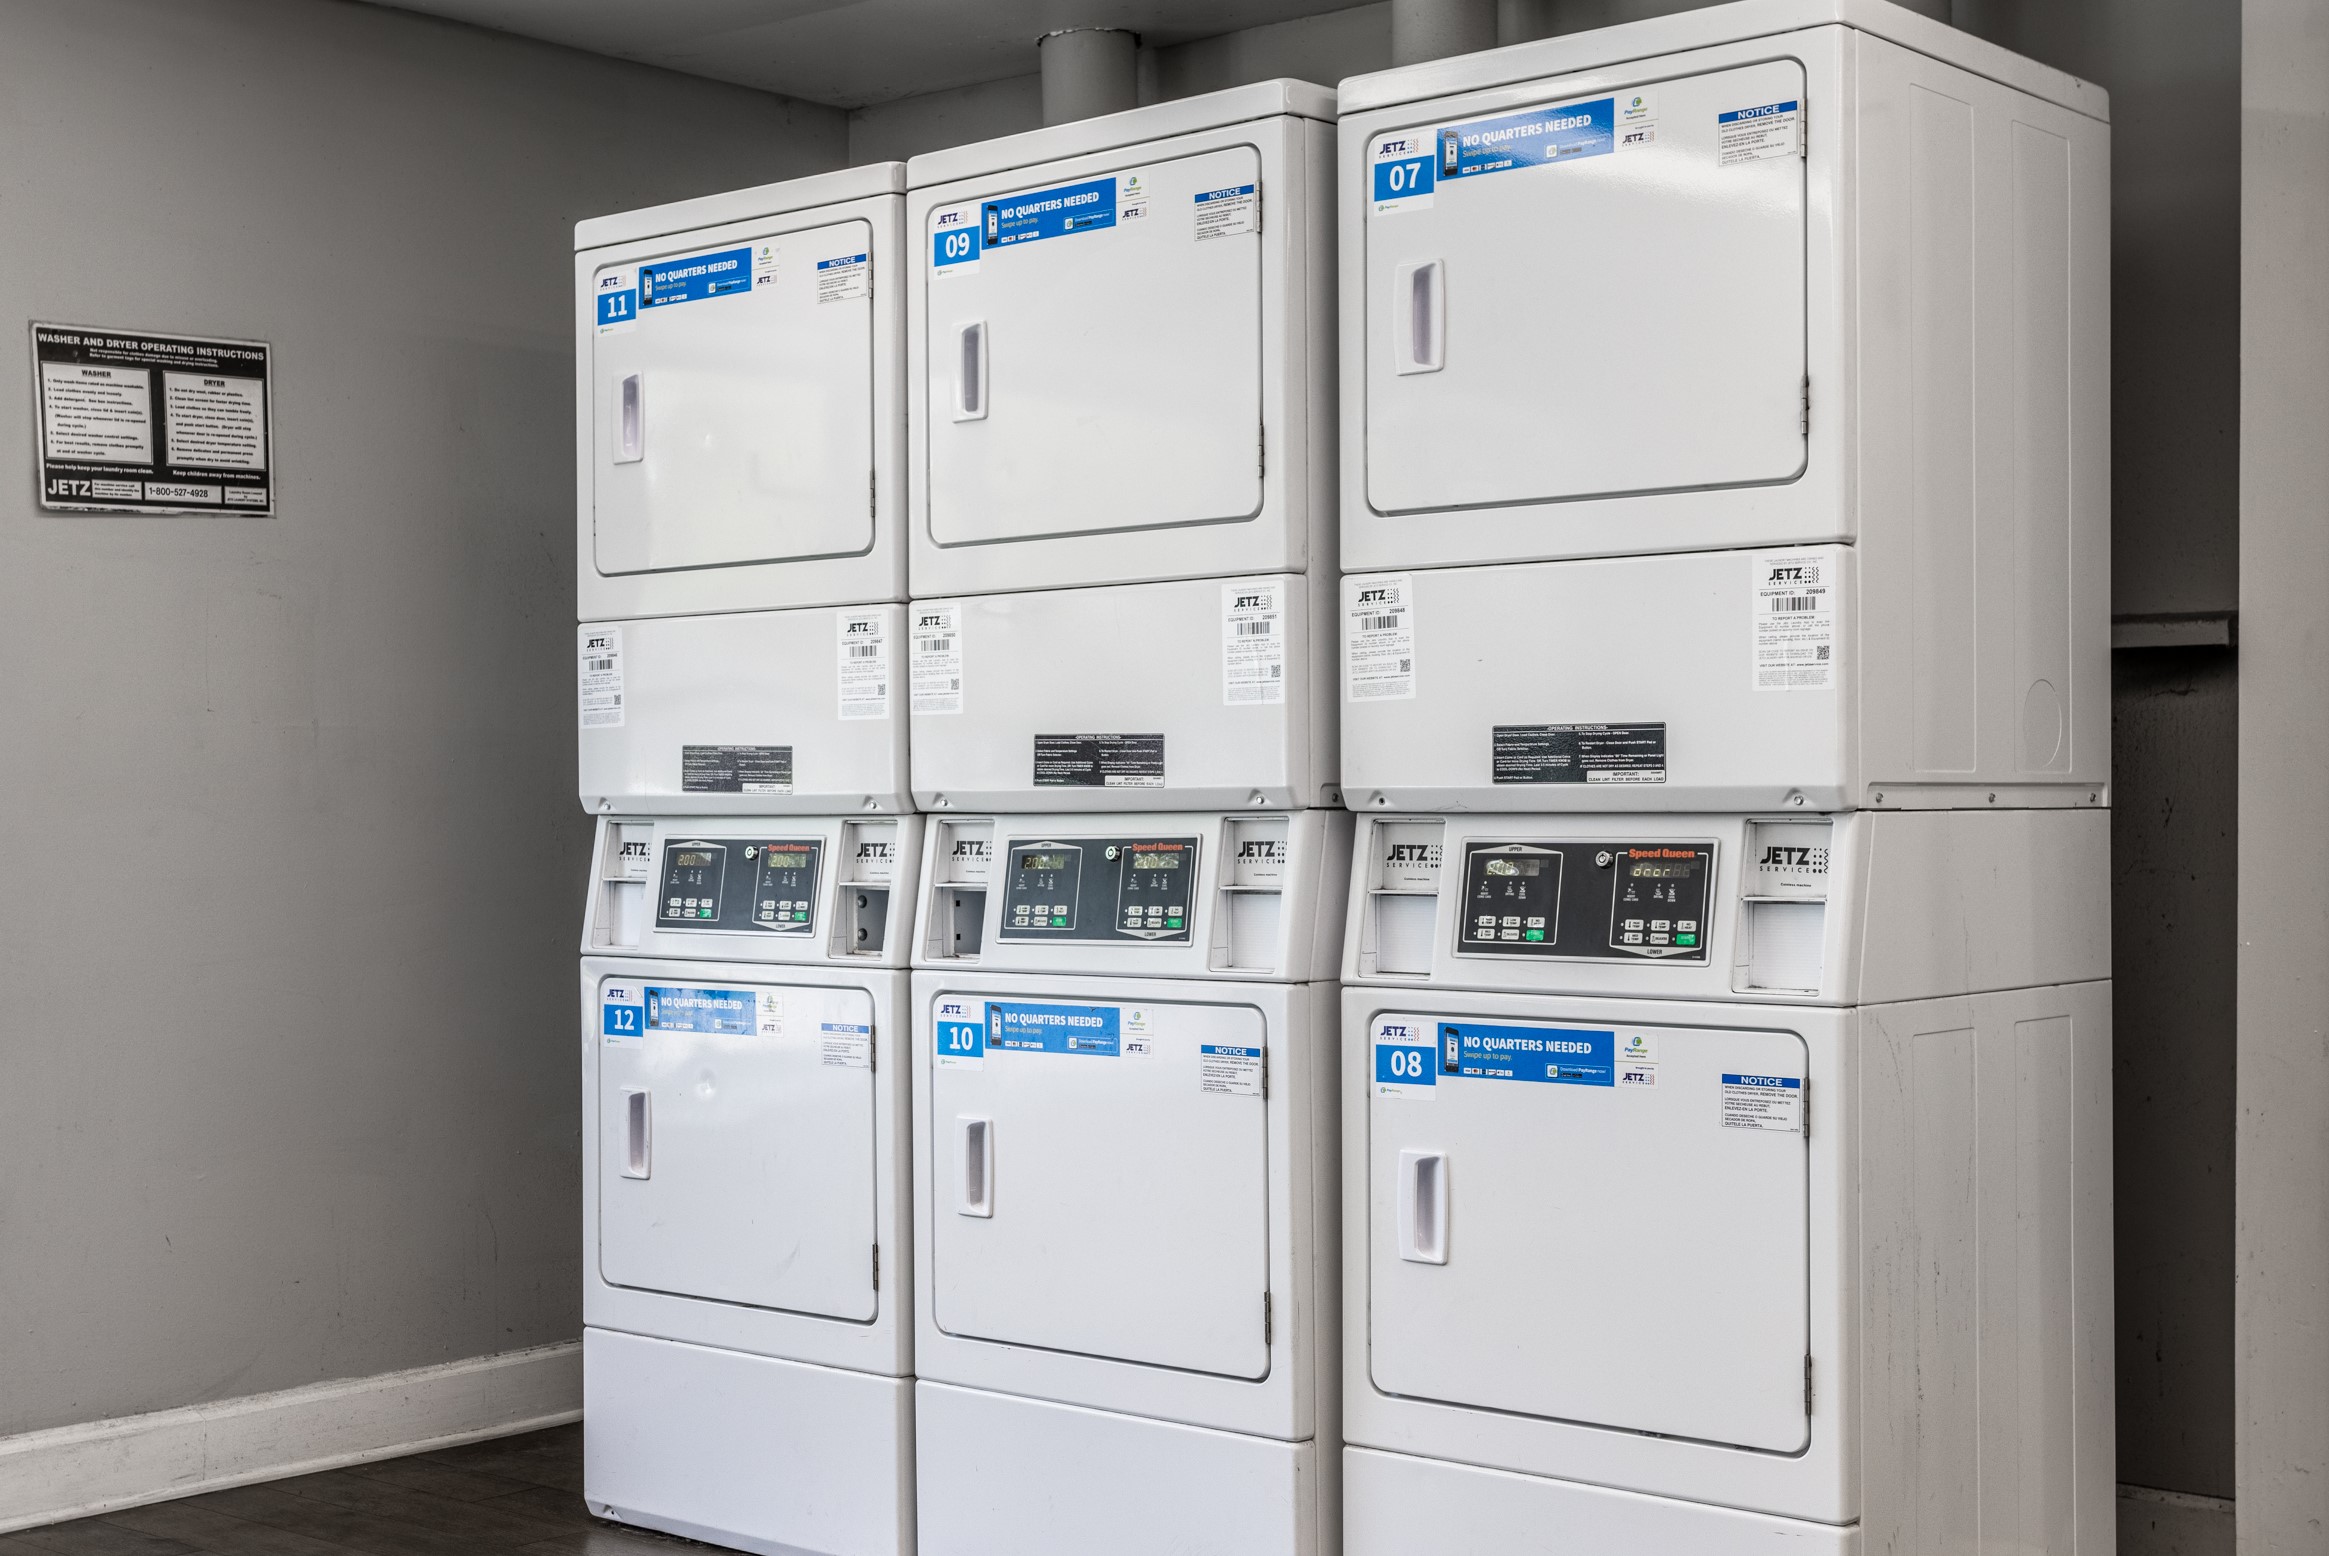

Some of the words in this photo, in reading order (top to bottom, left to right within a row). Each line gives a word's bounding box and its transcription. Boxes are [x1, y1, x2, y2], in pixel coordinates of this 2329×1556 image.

[1738, 104, 1780, 119] NOTICE
[1462, 134, 1482, 147] NO
[1484, 123, 1542, 146] QUARTERS
[1545, 115, 1592, 133] NEEDED
[1622, 132, 1645, 144] JETZ
[1380, 140, 1406, 154] JETZ
[1389, 162, 1421, 191] 07
[1209, 188, 1240, 200] NOTICE
[1001, 208, 1014, 219] NO
[1016, 199, 1062, 216] QUARTERS
[1064, 192, 1099, 208] NEEDED
[938, 213, 958, 225] JETZ
[1122, 208, 1139, 218] JETZ
[945, 232, 970, 258] 09
[828, 257, 855, 268] NOTICE
[655, 272, 666, 283] NO
[667, 265, 707, 280] QUARTERS
[708, 260, 738, 275] NEEDED
[600, 277, 618, 288] JETZ
[757, 276, 770, 285] JETZ
[607, 294, 628, 318] 11
[38, 333, 80, 345] WASHER
[83, 337, 104, 347] AND
[106, 339, 138, 350] DRYER
[140, 342, 194, 355] OPERATING
[196, 346, 265, 361] INSTRUCTIONS
[82, 370, 111, 379] WASHER
[204, 379, 225, 388] DRYER
[103, 466, 123, 474] laundry
[173, 470, 186, 478] Keep
[48, 479, 91, 497] JETZ
[149, 487, 208, 499] 1-800-527-4928
[1769, 567, 1802, 581] JETZ
[1358, 589, 1386, 602] JETZ
[1234, 596, 1259, 608] JETZ
[919, 616, 940, 626] JETZ
[847, 622, 868, 633] JETZ
[587, 638, 605, 648] JETZ
[619, 842, 646, 856] JETZ
[768, 844, 788, 853] Speed
[788, 844, 810, 852] Queen
[856, 843, 888, 857] JETZ
[952, 841, 984, 855] JETZ
[1132, 843, 1157, 852] Speed
[1158, 842, 1183, 851] Queen
[1237, 841, 1275, 857] JETZ
[1387, 844, 1428, 861] JETZ
[1629, 848, 1661, 859] Speed
[1662, 848, 1695, 858] Queen
[1760, 846, 1811, 865] JETZ
[1760, 865, 1810, 873] SERVICE
[607, 989, 624, 998] JETZ
[661, 997, 672, 1007] NO
[674, 998, 713, 1010] QUARTERS
[713, 1000, 743, 1010] NEEDED
[941, 1004, 961, 1014] JETZ
[614, 1009, 635, 1031] 12
[1005, 1013, 1019, 1024] NO
[1020, 1013, 1066, 1026] QUARTERS
[1067, 1015, 1103, 1028] NEEDED
[832, 1024, 858, 1033] NOTICE
[1380, 1026, 1407, 1037] JETZ
[949, 1026, 974, 1051] 10
[1126, 1043, 1143, 1052] JETZ
[1215, 1046, 1247, 1056] NOTICE
[1464, 1036, 1481, 1048] NO
[1483, 1037, 1543, 1052] QUARTERS
[1545, 1040, 1592, 1054] NEEDED
[1624, 1047, 1648, 1055] PayRange
[1464, 1051, 1481, 1060] Swipe
[1492, 1052, 1500, 1060] to
[1501, 1053, 1512, 1062] pay.
[1390, 1050, 1422, 1077] 08
[1623, 1073, 1644, 1082] JETZ
[1741, 1076, 1783, 1087] NOTICE
